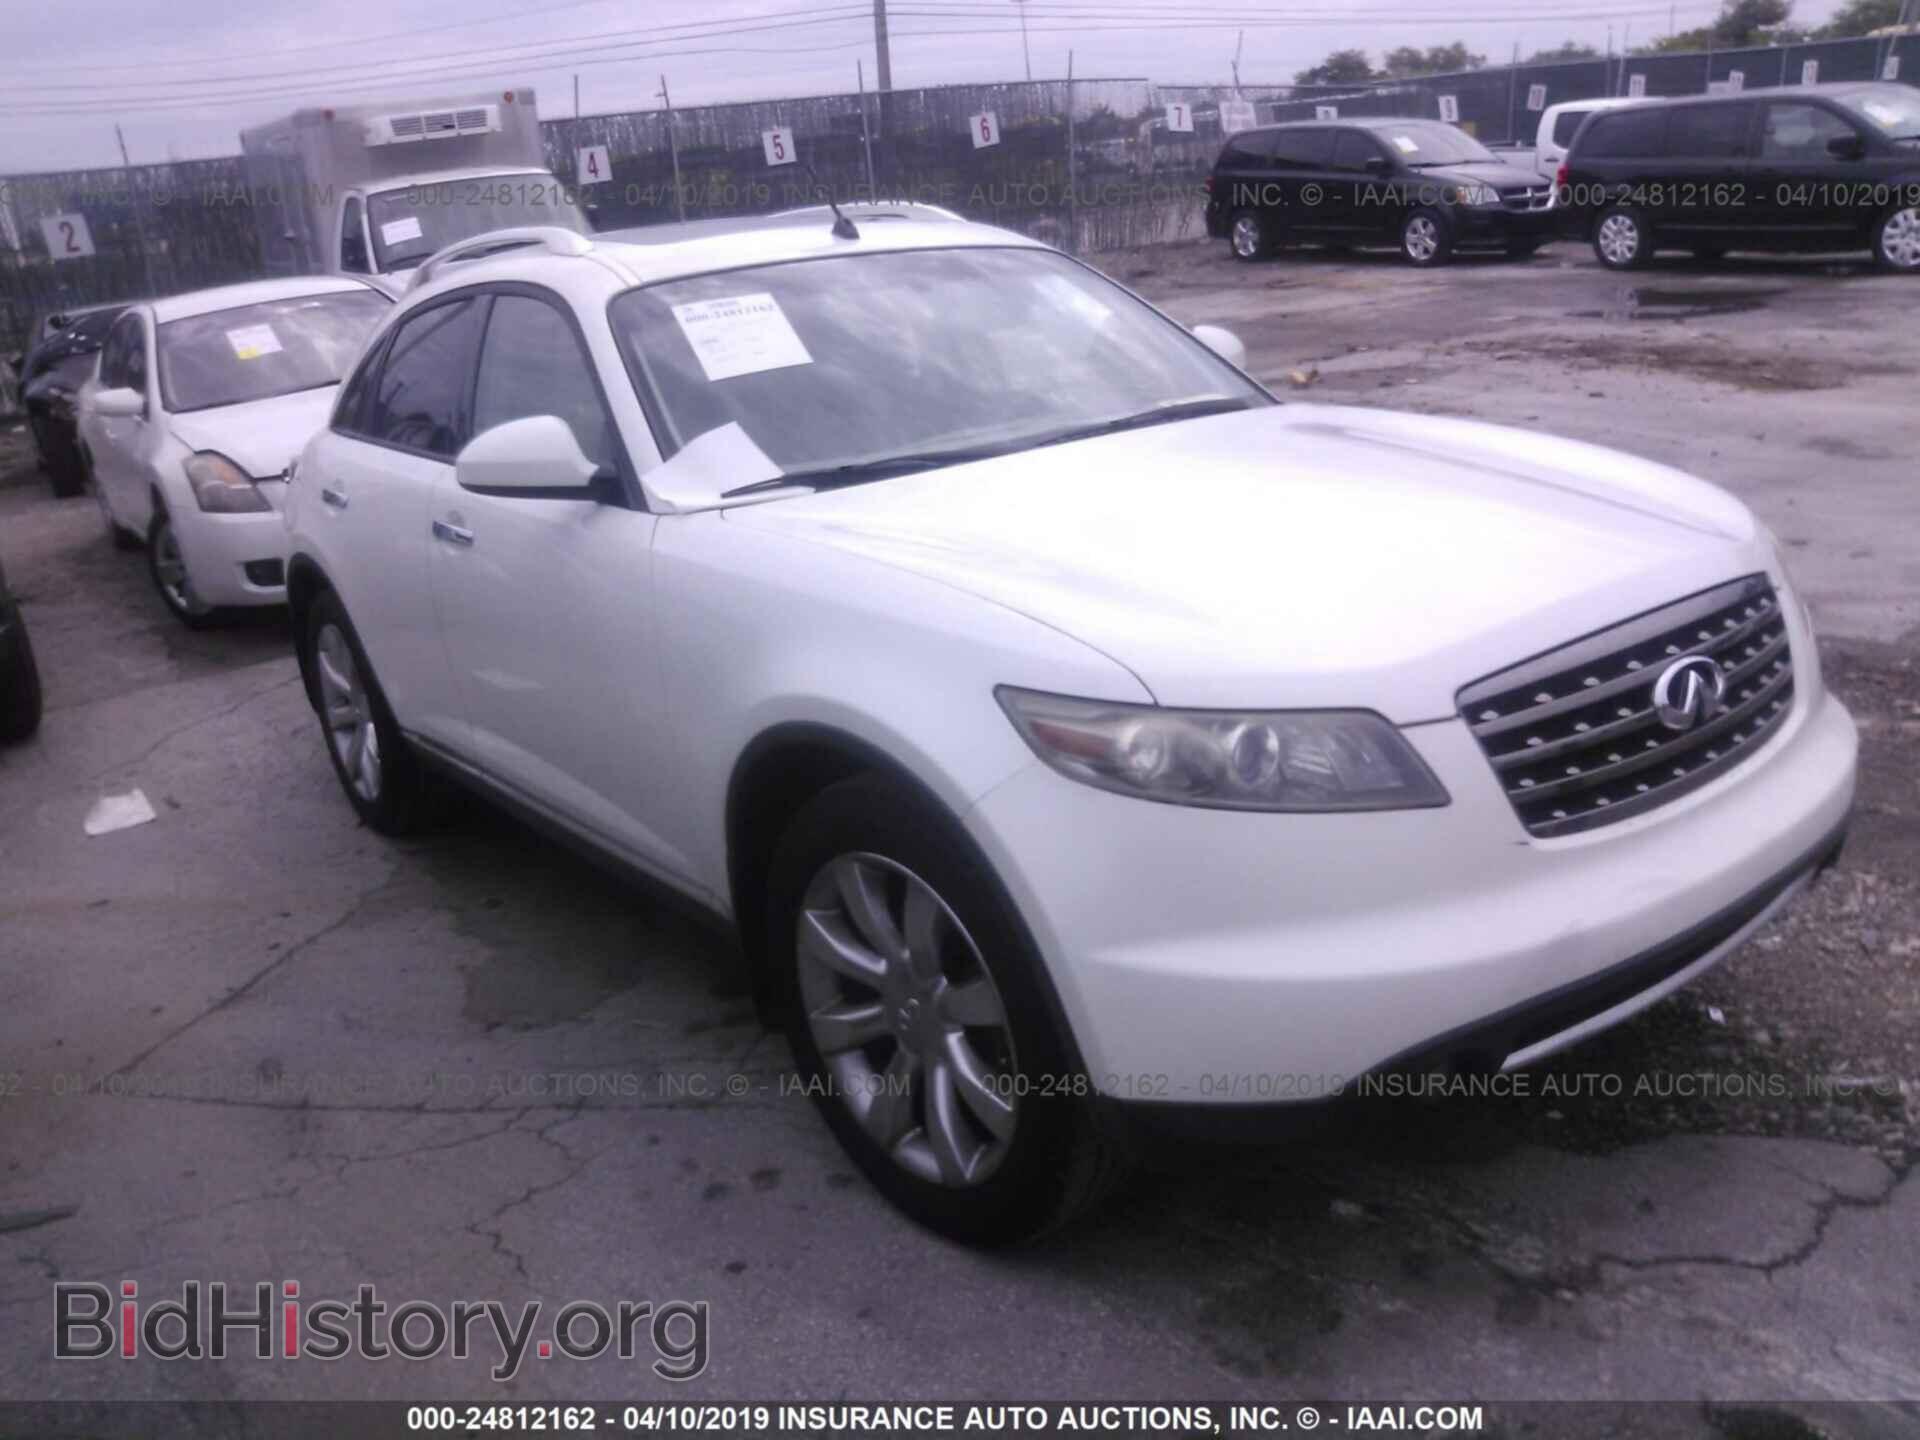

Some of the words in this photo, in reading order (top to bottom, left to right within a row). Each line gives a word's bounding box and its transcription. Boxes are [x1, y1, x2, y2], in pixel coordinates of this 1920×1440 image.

[978, 117, 991, 143] 6
[1174, 106, 1183, 128] 7
[772, 134, 785, 161] 5
[587, 151, 600, 177] 4
[59, 222, 80, 253] 2
